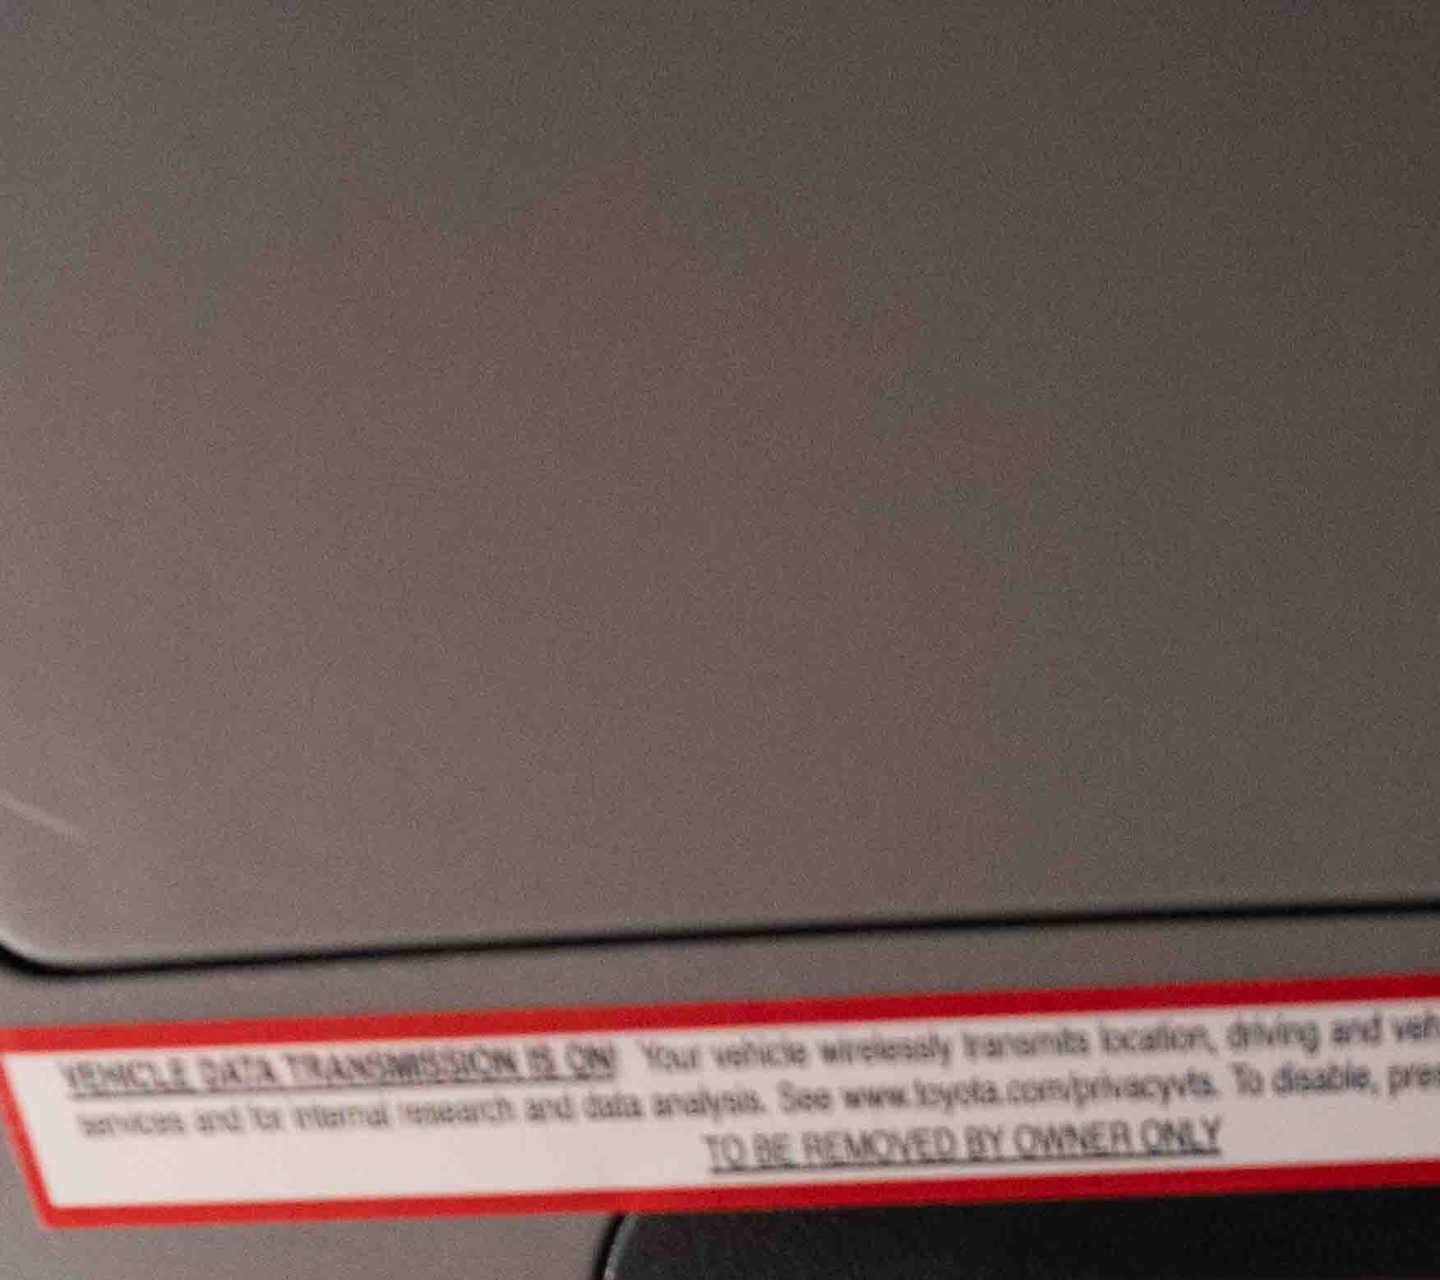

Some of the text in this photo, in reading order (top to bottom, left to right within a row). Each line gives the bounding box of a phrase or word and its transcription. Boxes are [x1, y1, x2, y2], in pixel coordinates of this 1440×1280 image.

[198, 1054, 278, 1090] DATA
[283, 1048, 517, 1086] TRANSMISSION
[640, 1041, 698, 1072] Your
[714, 1040, 806, 1071] vehicle
[818, 1030, 951, 1067] wirelessly
[962, 1028, 1090, 1062] transmits
[1226, 1015, 1320, 1055] driving
[1329, 1012, 1382, 1045] and
[196, 1106, 247, 1134] and
[526, 1094, 575, 1124] and
[582, 1089, 645, 1120] data
[776, 1080, 830, 1114] See
[1227, 1061, 1265, 1097] To
[703, 1111, 1224, 1168] TO BE REMOVED BY OWNER ONLY
